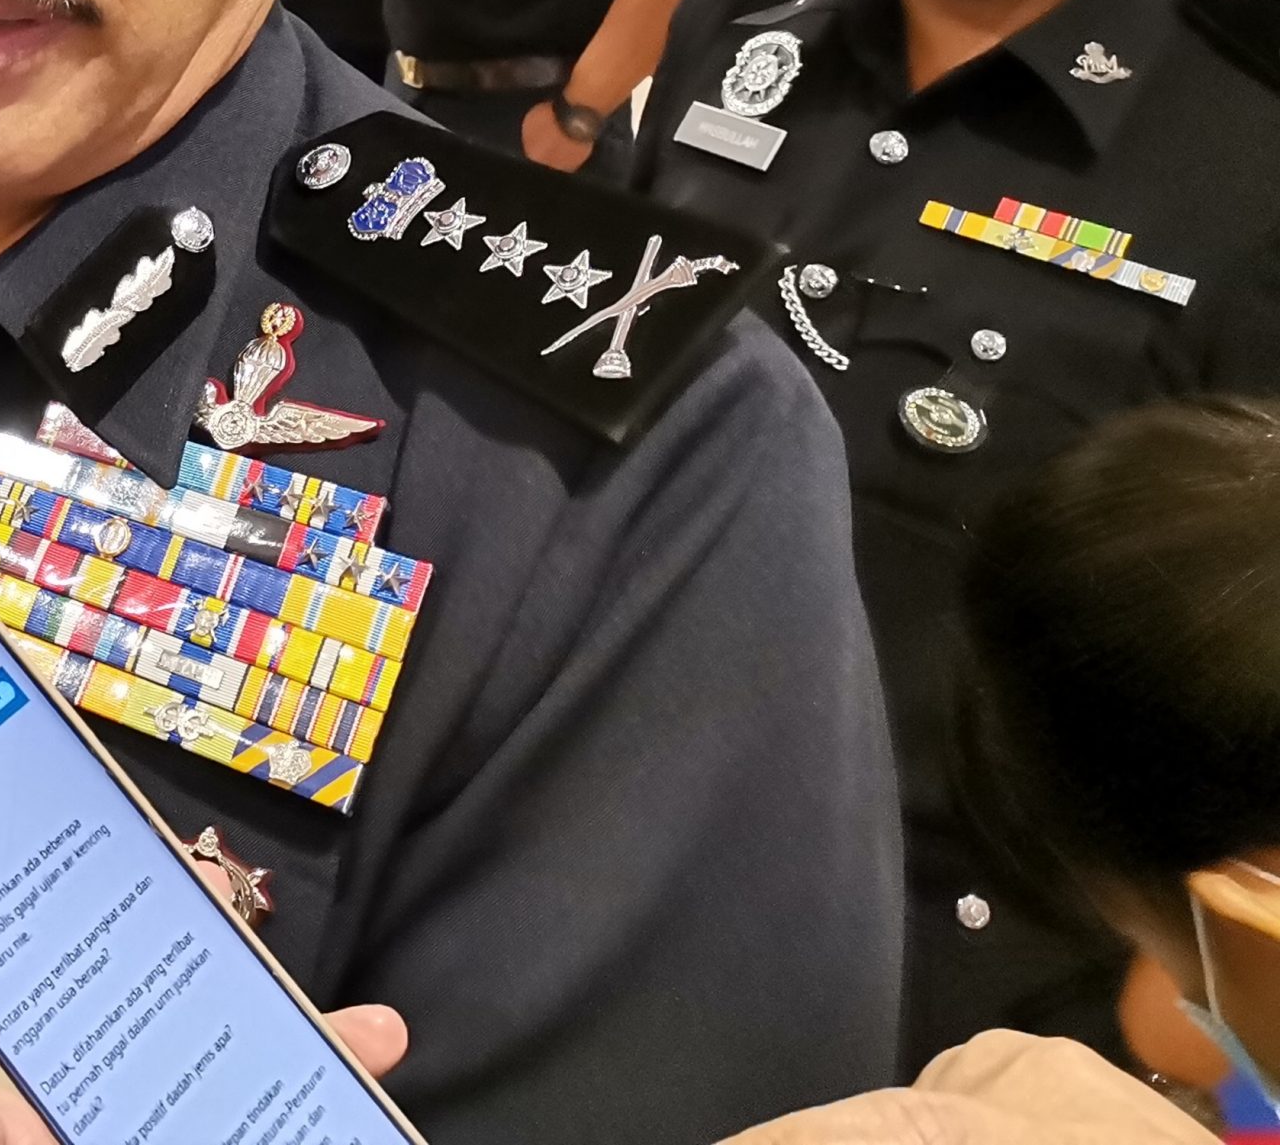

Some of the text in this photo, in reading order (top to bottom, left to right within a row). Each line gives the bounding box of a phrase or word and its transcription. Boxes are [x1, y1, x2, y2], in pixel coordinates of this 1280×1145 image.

[13, 886, 40, 920] gagal
[39, 867, 63, 893] ujian
[61, 855, 74, 872] air
[73, 824, 111, 858] kencing
[22, 857, 42, 877] ada
[39, 819, 82, 860] beberapa
[27, 976, 56, 1007] yang
[50, 943, 86, 980] terlibat
[83, 908, 121, 949] pangkat
[118, 892, 137, 913] apa
[135, 875, 153, 896] dan
[12, 947, 111, 1056] anggaran usia berapa?
[68, 1064, 103, 1106] pernah
[102, 1034, 129, 1071] gagal
[127, 1007, 157, 1040] dalam
[172, 948, 211, 995] jugakkan
[73, 1004, 127, 1063] difahamkan
[125, 986, 144, 1008] ada
[141, 963, 168, 993] yang
[162, 931, 194, 967] terlibat
[73, 1095, 103, 1137] datuk?
[137, 1024, 232, 1141] positif dadah jenis apa?
[246, 1080, 283, 1124] tindakan
[307, 1104, 326, 1127] dan
